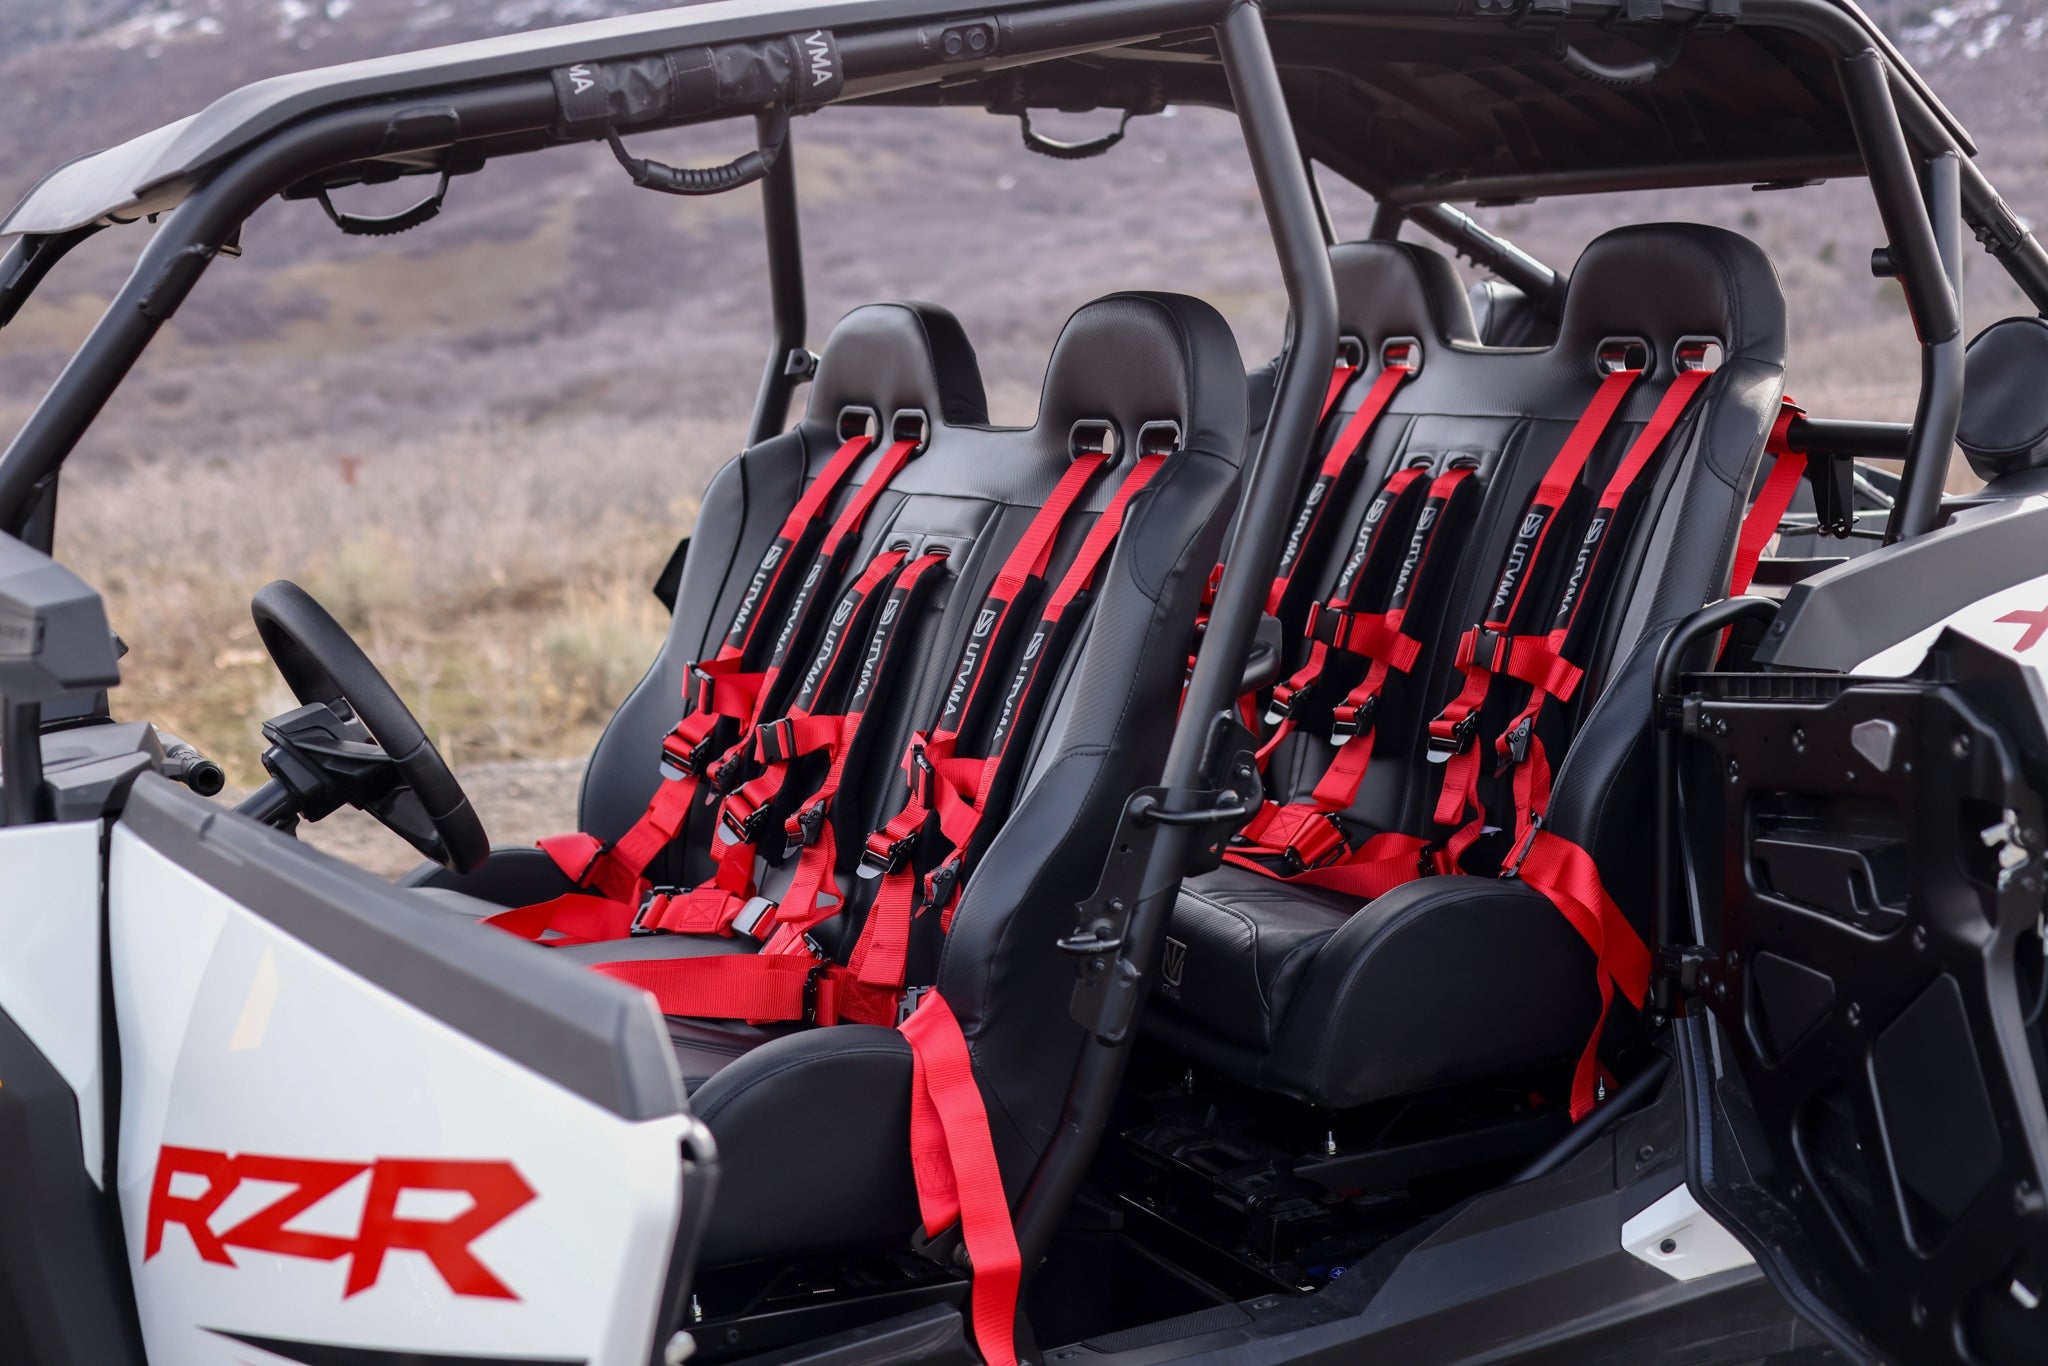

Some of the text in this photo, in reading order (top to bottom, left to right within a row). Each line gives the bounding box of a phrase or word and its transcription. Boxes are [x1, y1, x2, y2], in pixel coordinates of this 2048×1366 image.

[1280, 508, 1312, 566] UTVMA
[1340, 527, 1372, 588] UTVMA
[1393, 535, 1423, 597] UTVMA
[731, 572, 767, 634] UTVMA
[1493, 543, 1529, 609] UTVMA
[1557, 549, 1591, 616] UTVMA
[801, 630, 837, 695] UTVMA
[853, 630, 886, 698] UTVMA
[944, 642, 981, 716] UTVMA
[143, 1143, 539, 1302] RZR
